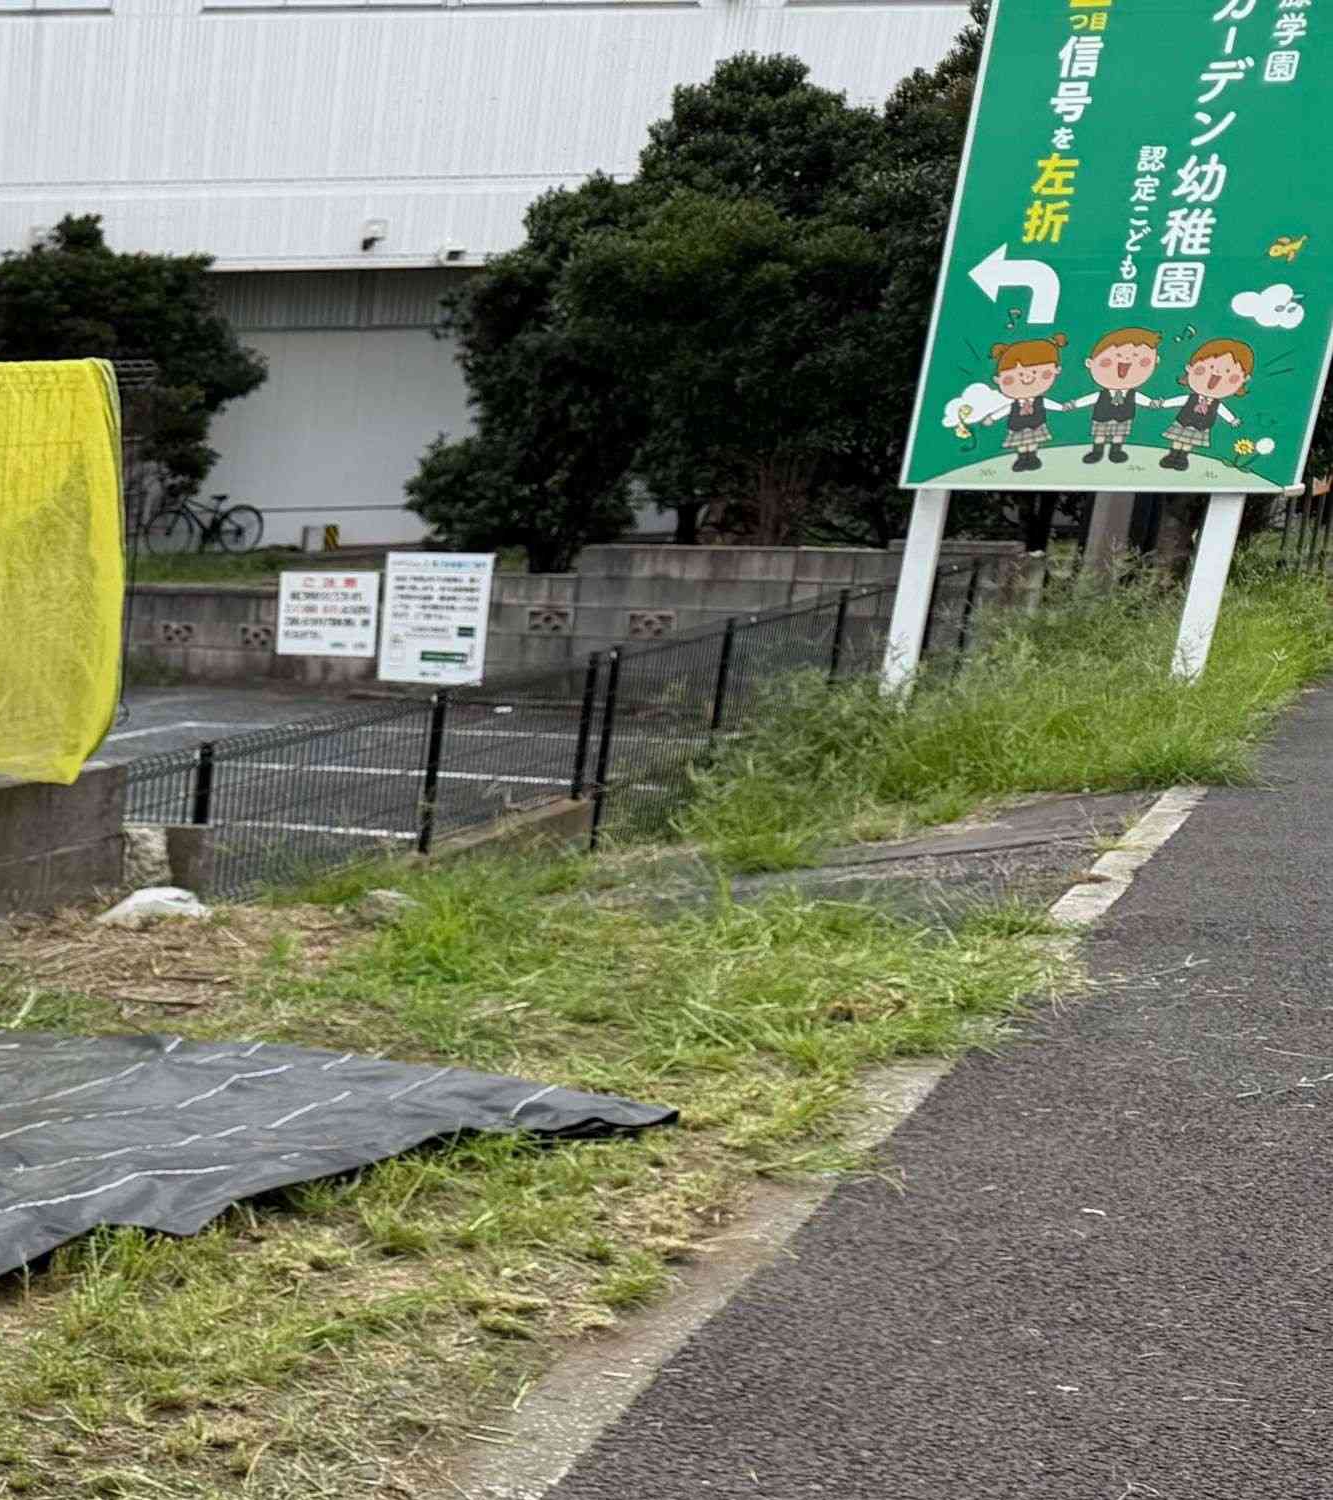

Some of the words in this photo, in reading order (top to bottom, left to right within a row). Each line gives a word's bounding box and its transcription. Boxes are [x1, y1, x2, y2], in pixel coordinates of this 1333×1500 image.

[1022, 0, 1112, 245] つ目信号を左折
[1263, 0, 1313, 82] 学園
[1108, 145, 1167, 308] 認定こども園
